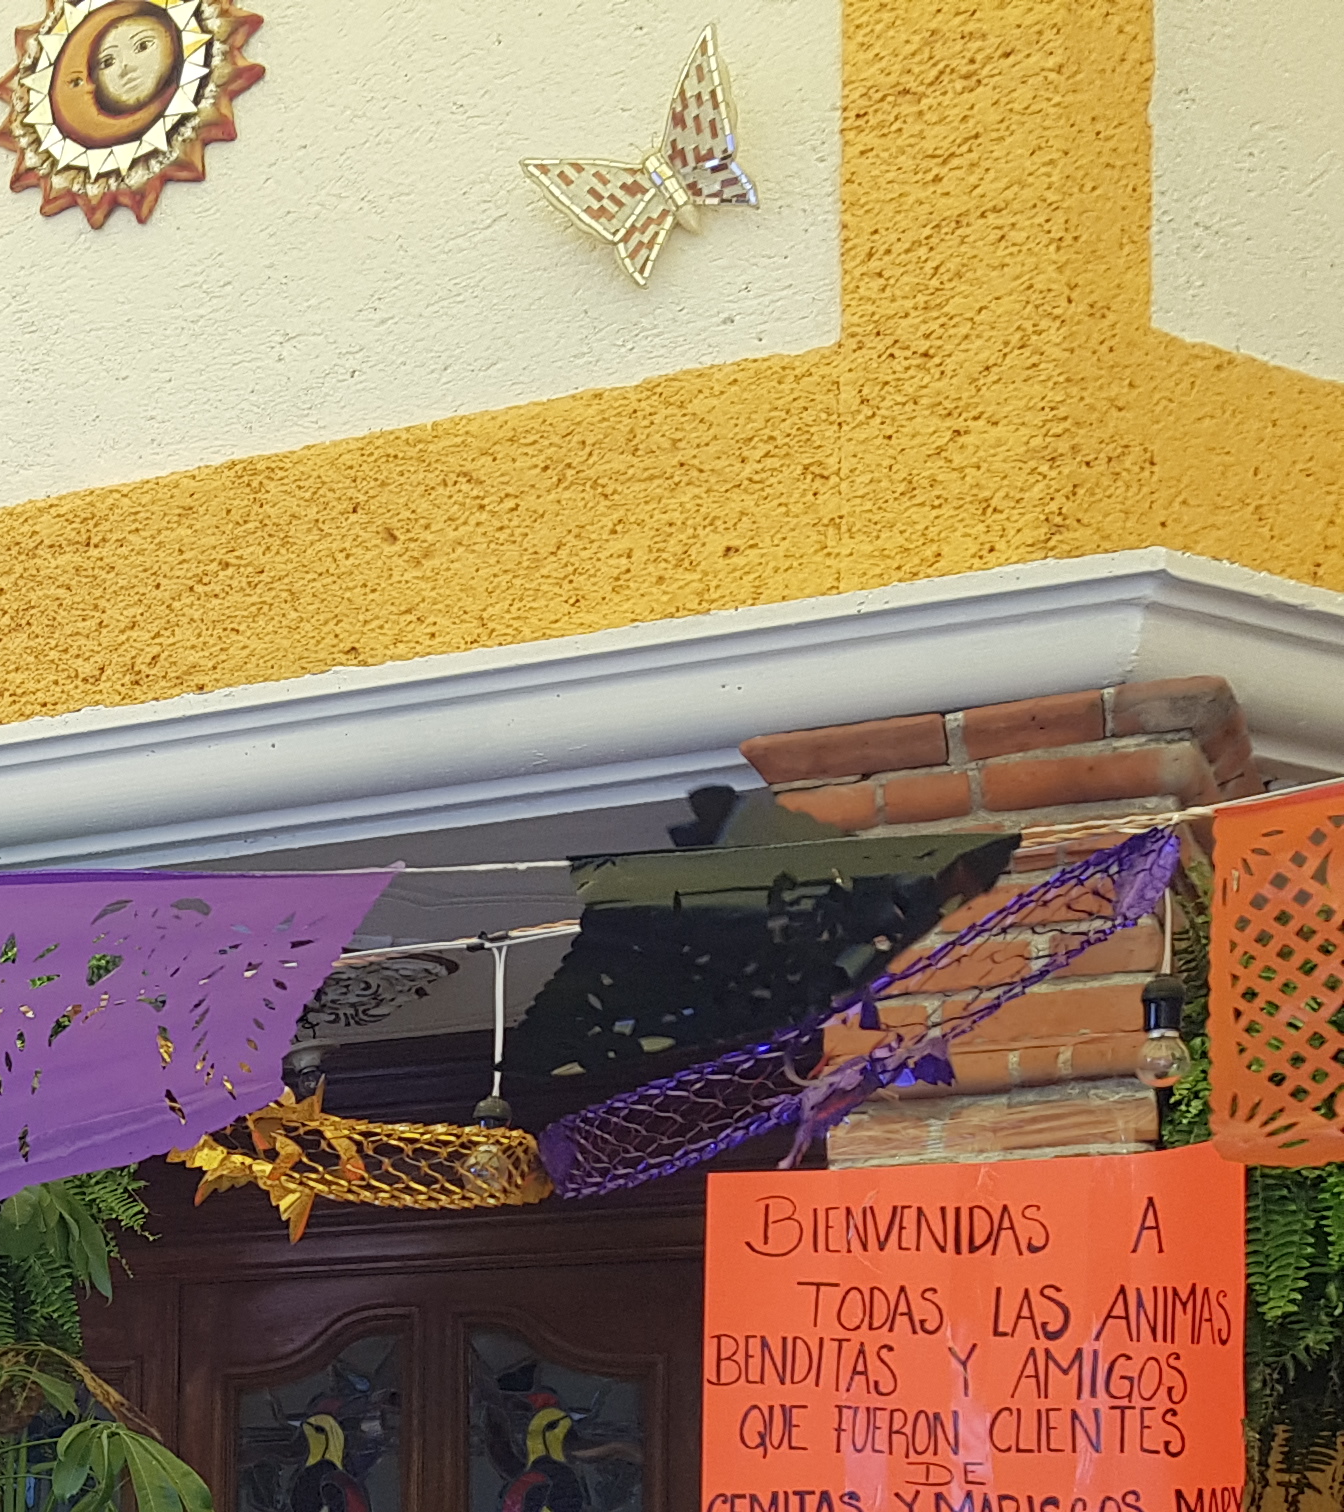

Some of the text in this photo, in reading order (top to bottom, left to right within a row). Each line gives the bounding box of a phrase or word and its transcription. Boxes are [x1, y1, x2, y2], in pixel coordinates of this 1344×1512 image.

[745, 1195, 1165, 1257] BIENVENIDAS A
[796, 1280, 1232, 1346] TODAS LAS ANIMAS
[706, 1333, 1188, 1405] BENDITAS Y AMIGOS
[739, 1404, 1185, 1459] QUE FUERON CLIENTES
[904, 1461, 987, 1486] DE
